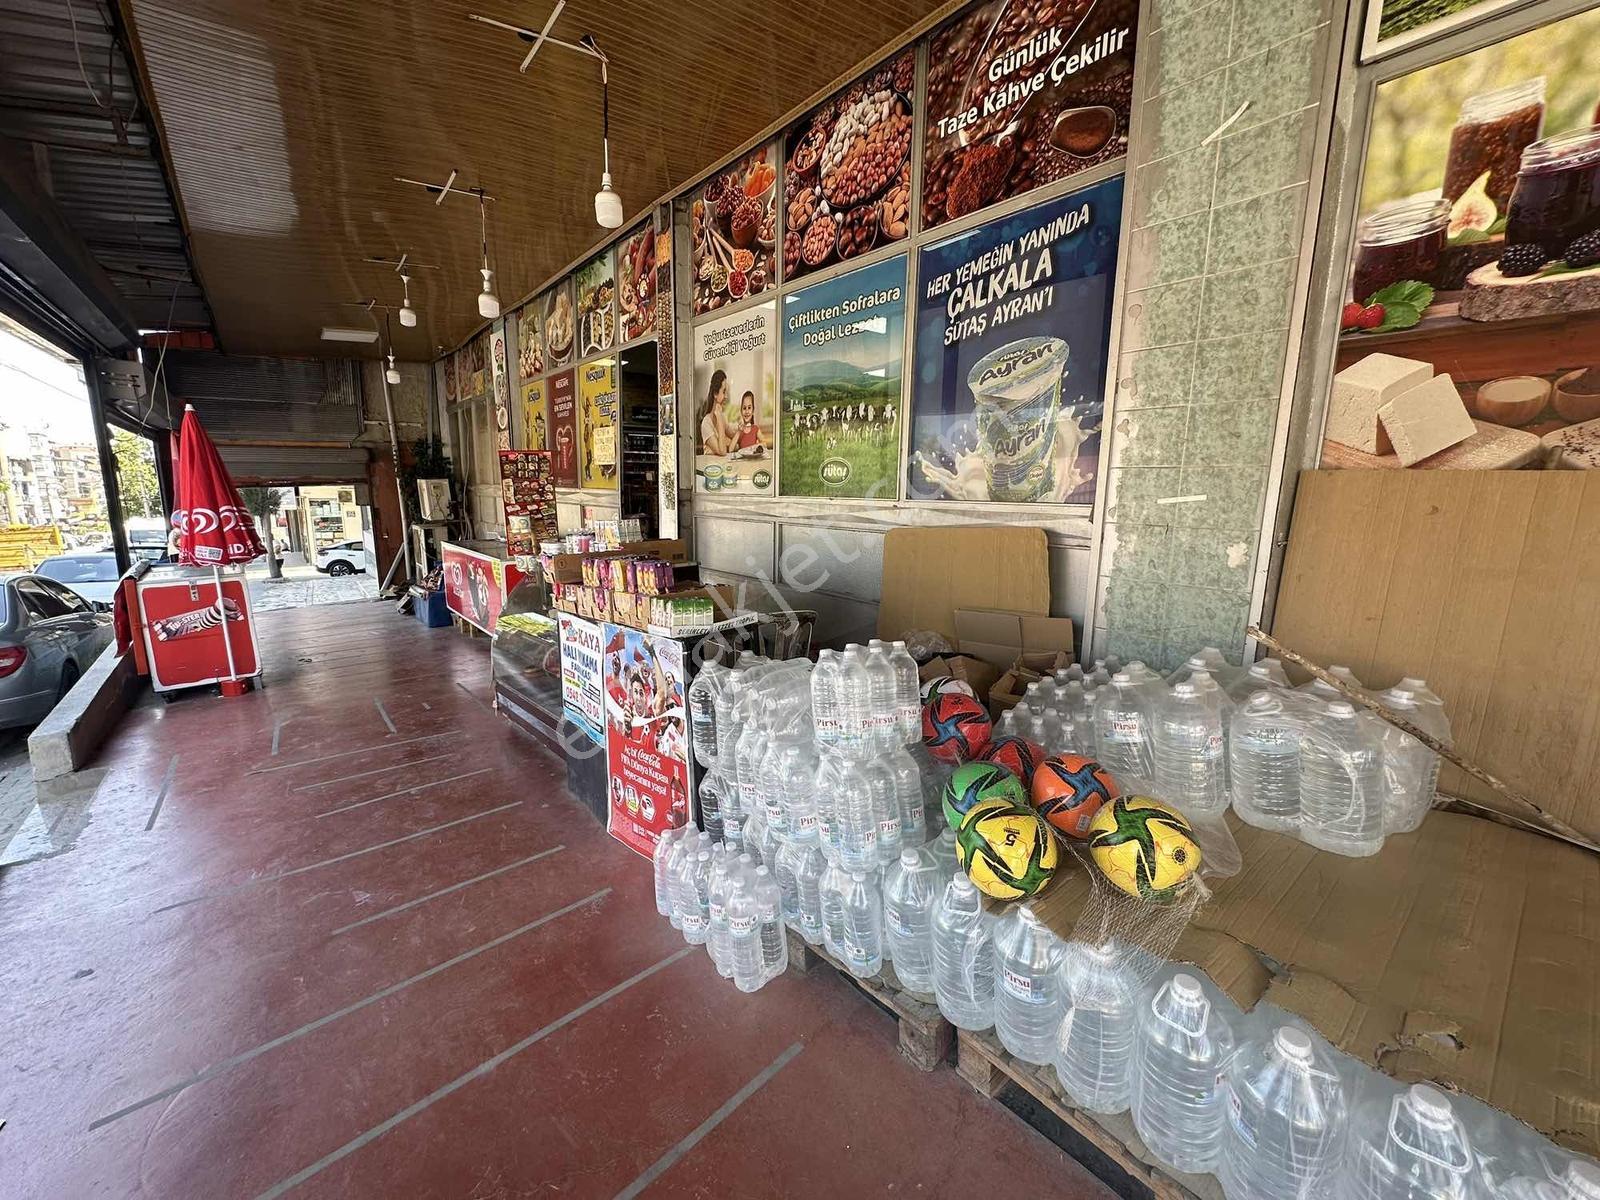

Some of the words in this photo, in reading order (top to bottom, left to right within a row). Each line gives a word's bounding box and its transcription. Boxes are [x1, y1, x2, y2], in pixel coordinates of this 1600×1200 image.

[988, 26, 1063, 82] Günlük
[937, 105, 978, 139] Taze
[983, 72, 1045, 120] Kahve
[1049, 27, 1129, 88] Çekilir
[927, 273, 951, 299] HER
[956, 240, 1014, 286] YEMEĞİN
[1019, 203, 1090, 256] YANINDA
[947, 247, 1053, 324] ÇALKALA
[788, 304, 840, 333] Çiftlikten
[841, 286, 901, 315] Sofralara
[703, 314, 765, 346] Yoğurtseverlerin
[803, 326, 836, 348] Doğal
[943, 313, 987, 346] SÜTAŞ
[703, 342, 739, 363] Güvendiği
[739, 332, 766, 353] Yoğurt
[979, 343, 1054, 386] Ayran
[994, 419, 1046, 458] Ayran
[578, 628, 601, 654] KAYA
[1113, 722, 1137, 731] Pirsu
[1005, 833, 1017, 847] 5
[1004, 969, 1030, 988] Pirsu
